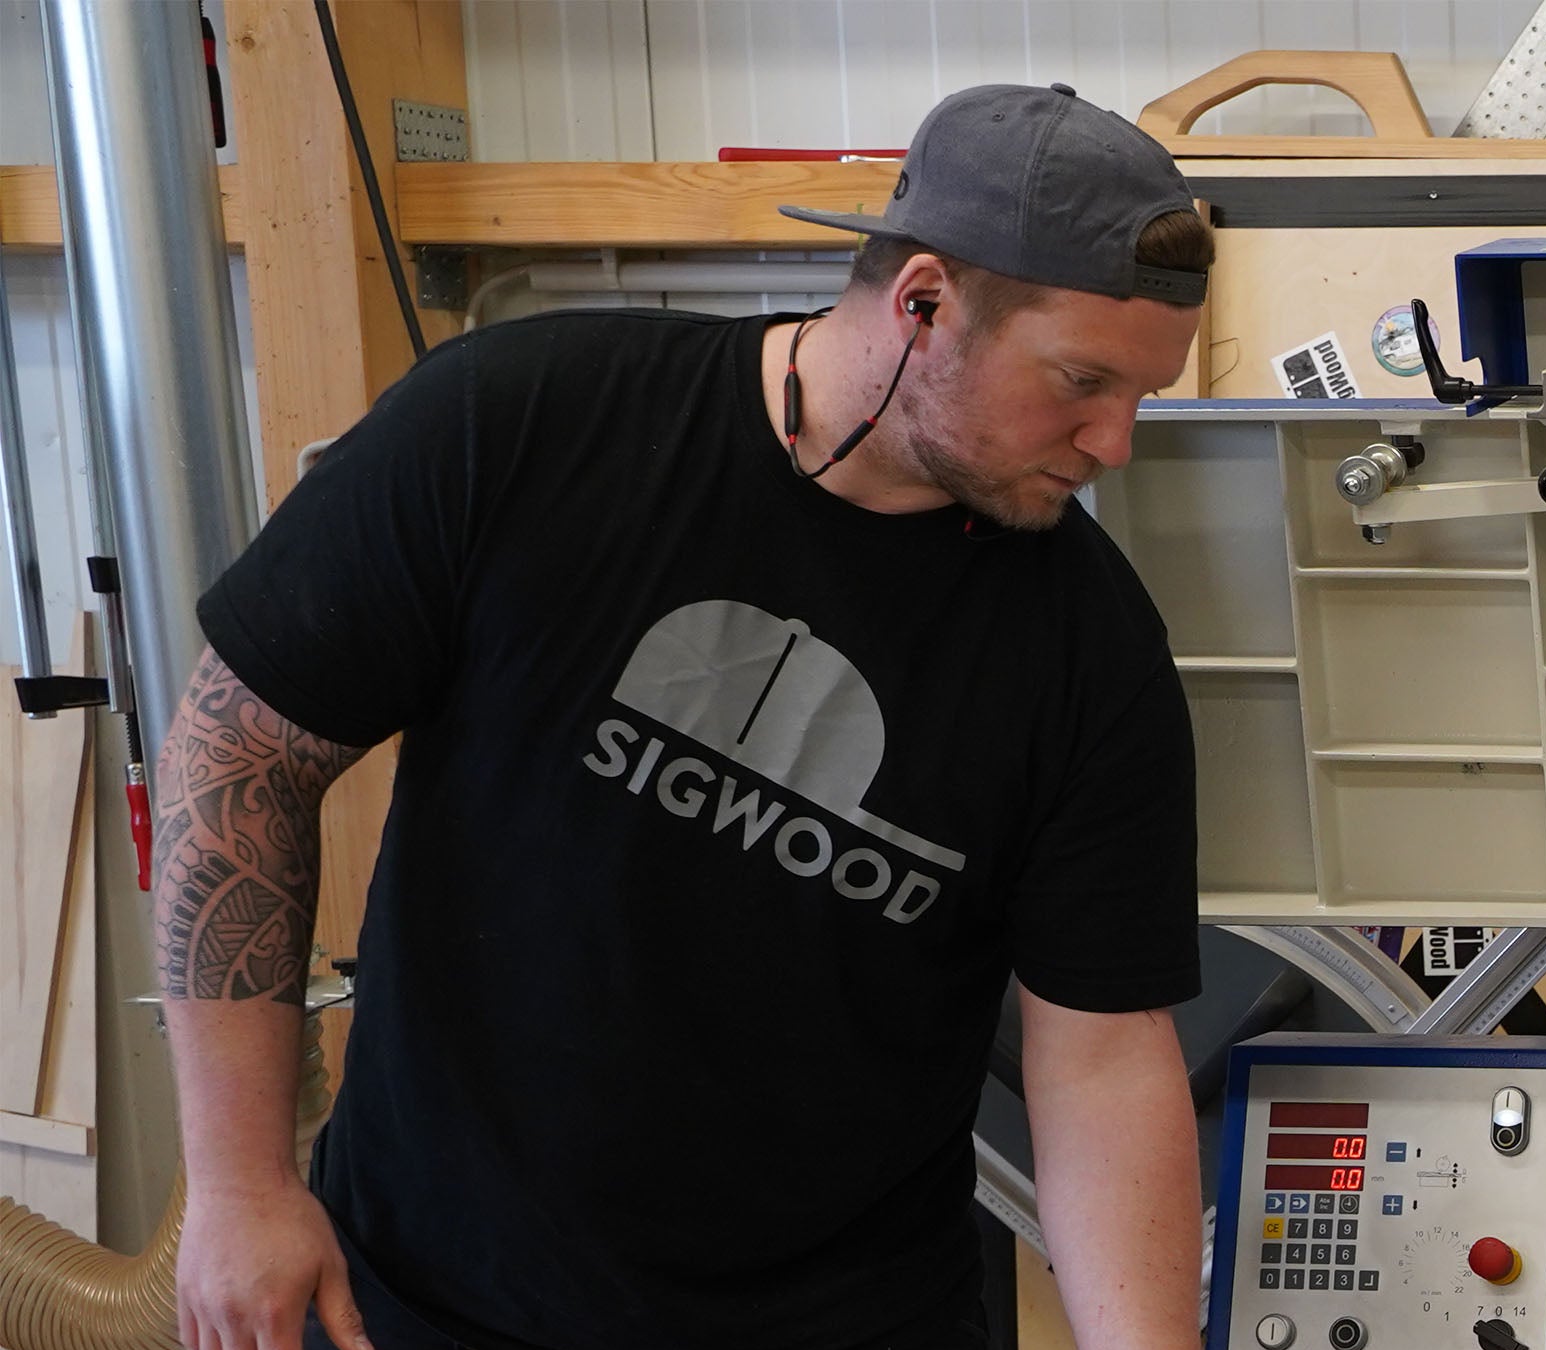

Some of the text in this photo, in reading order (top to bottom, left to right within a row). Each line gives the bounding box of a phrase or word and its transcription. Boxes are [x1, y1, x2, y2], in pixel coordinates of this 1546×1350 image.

[582, 719, 941, 924] SIGWOOD
[1332, 1137, 1365, 1159] 0.0
[1330, 1168, 1362, 1190] 0.0
[1266, 1223, 1352, 1235] CE 7 8 9
[1415, 1230, 1424, 1238] 10
[1433, 1226, 1442, 1234] 12
[1292, 1248, 1350, 1260] 4 5 6
[1266, 1273, 1348, 1286] 0 1 2 3
[1454, 1286, 1464, 1294] 22
[1423, 1301, 1431, 1312] 0
[1477, 1306, 1526, 1317] 7 0 14
